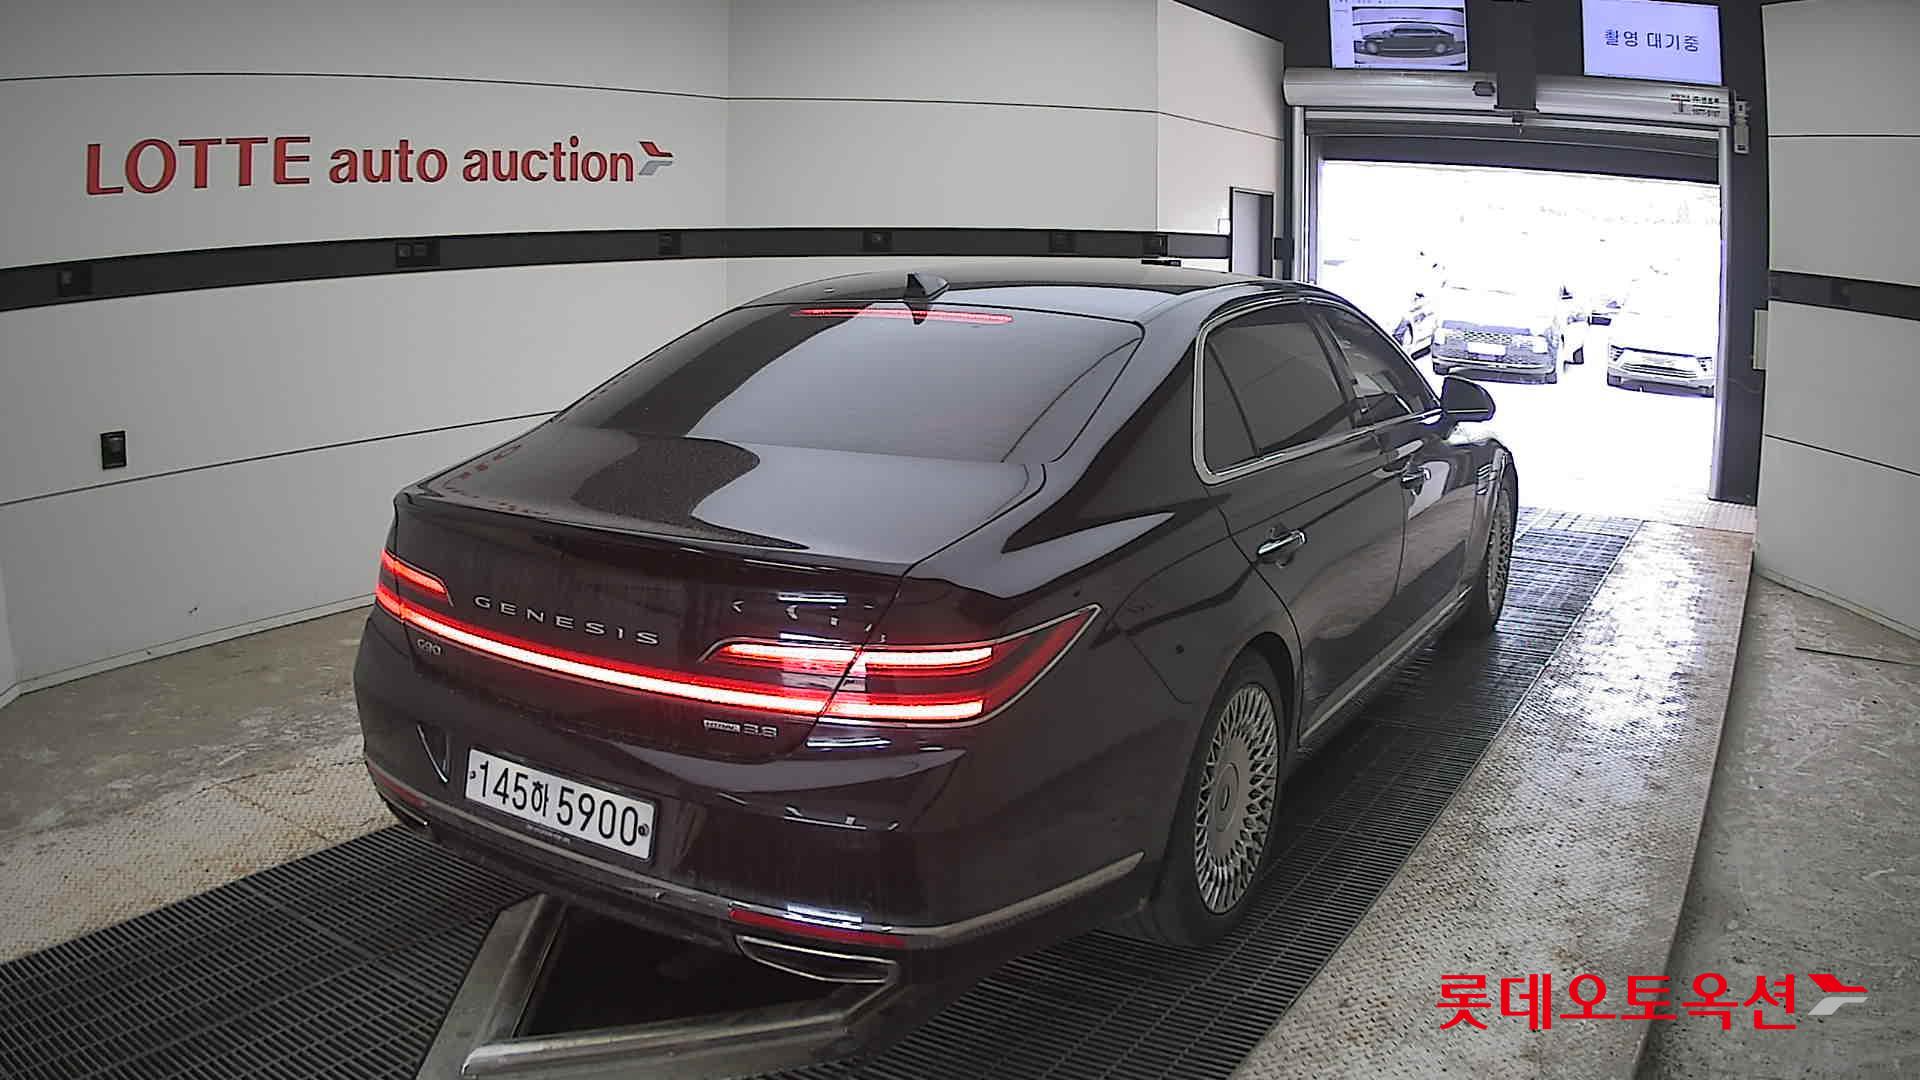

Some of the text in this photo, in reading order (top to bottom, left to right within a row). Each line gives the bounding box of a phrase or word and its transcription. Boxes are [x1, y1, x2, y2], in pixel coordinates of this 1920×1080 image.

[1646, 32, 1699, 52] 대기중
[86, 135, 634, 195] LOTTE auto auction
[471, 595, 660, 646] GENESIS
[480, 760, 639, 847] 145하 5900
